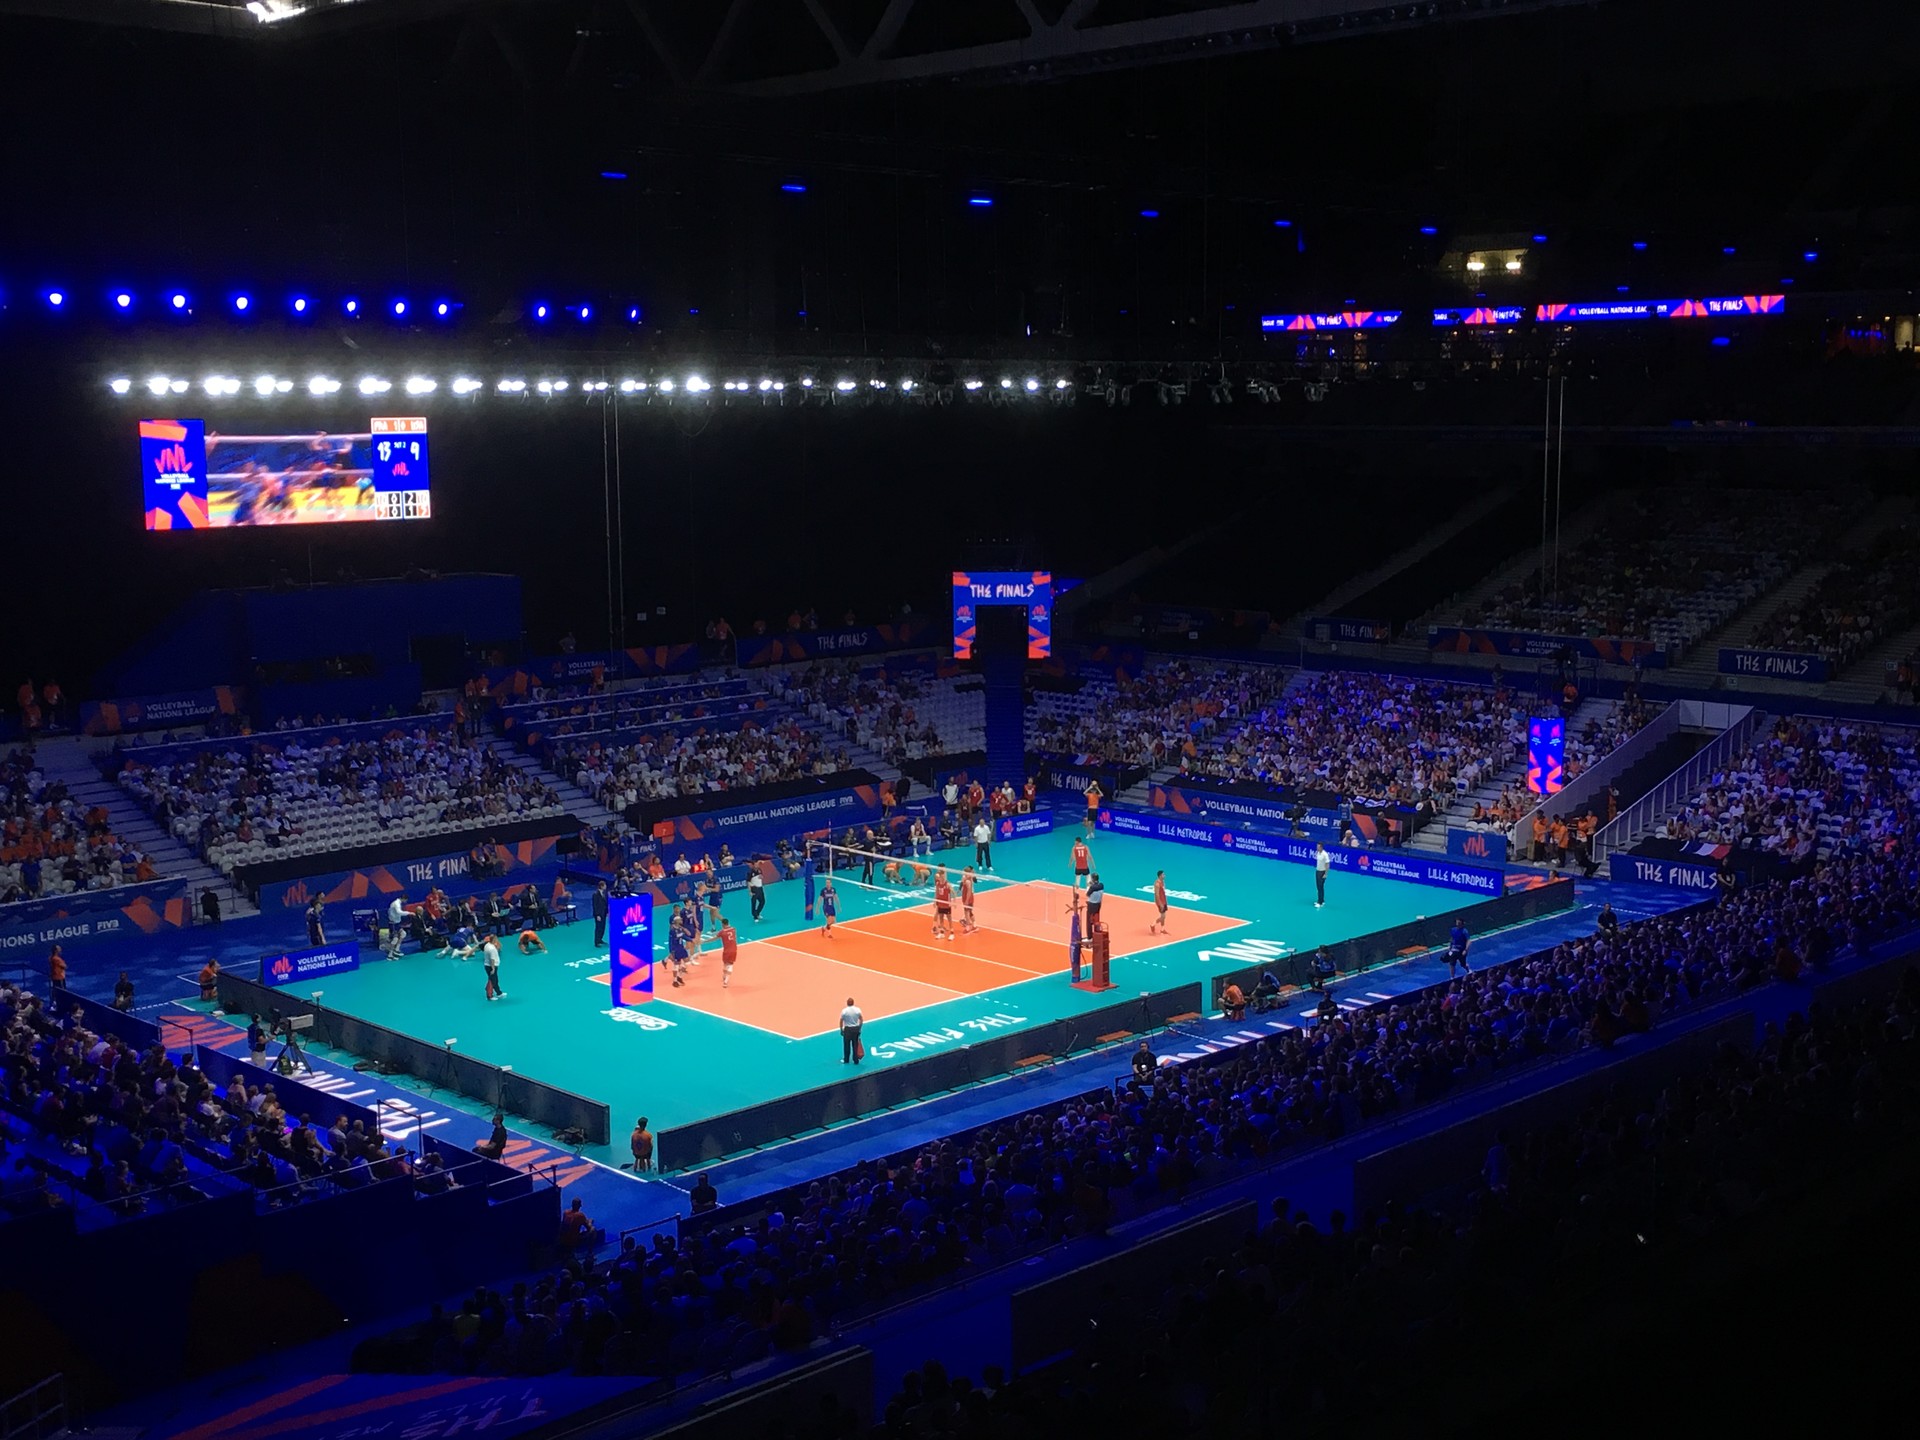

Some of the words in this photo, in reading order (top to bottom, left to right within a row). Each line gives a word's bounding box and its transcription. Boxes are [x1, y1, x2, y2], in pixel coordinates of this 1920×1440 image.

[1578, 307, 1609, 315] VOLLEYBALL
[1610, 306, 1633, 314] NATIONS
[970, 584, 992, 598] THE
[996, 584, 1034, 598] FINALS
[1340, 623, 1356, 637] THE
[817, 635, 836, 649] THE
[838, 632, 868, 648] FINALS
[568, 667, 594, 676] NATION
[1736, 655, 1759, 672] THE
[1765, 657, 1809, 675] FINALS
[146, 700, 195, 711] VOLLEYBALL
[147, 709, 182, 720] NATIONS
[184, 705, 216, 716] LEAGUE
[1051, 770, 1063, 788] HE
[1065, 774, 1089, 791] FINA
[718, 810, 769, 827] VOLLEYBALL
[770, 804, 805, 818] NATIONS
[806, 798, 836, 812] LEAGUE
[1205, 800, 1254, 815] VOLLEYBALL
[1256, 807, 1293, 821] NATIO
[1300, 813, 1328, 827] EAGUE
[1158, 822, 1175, 836] LILLE
[1176, 827, 1212, 842] METROPOLE
[1288, 844, 1307, 858] LILLE
[407, 863, 434, 883] THE
[439, 856, 471, 878] FINA
[1373, 859, 1406, 870] VOLLEYBALL
[1373, 865, 1397, 875] NATIONS
[1398, 869, 1420, 879] LEAGUE
[1428, 867, 1449, 881] LILLE
[1451, 872, 1494, 889] METROPOLE
[1635, 861, 1663, 882] THE
[1669, 866, 1718, 889] FINALS
[40, 924, 90, 942] LEAGUE
[96, 920, 120, 931] FIVB
[297, 953, 337, 965] VOLLEYBALL
[298, 961, 326, 972] NATIONS
[328, 956, 352, 967] LEAGUE
[959, 1013, 1027, 1031] THE
[870, 1027, 965, 1059] FINALS
